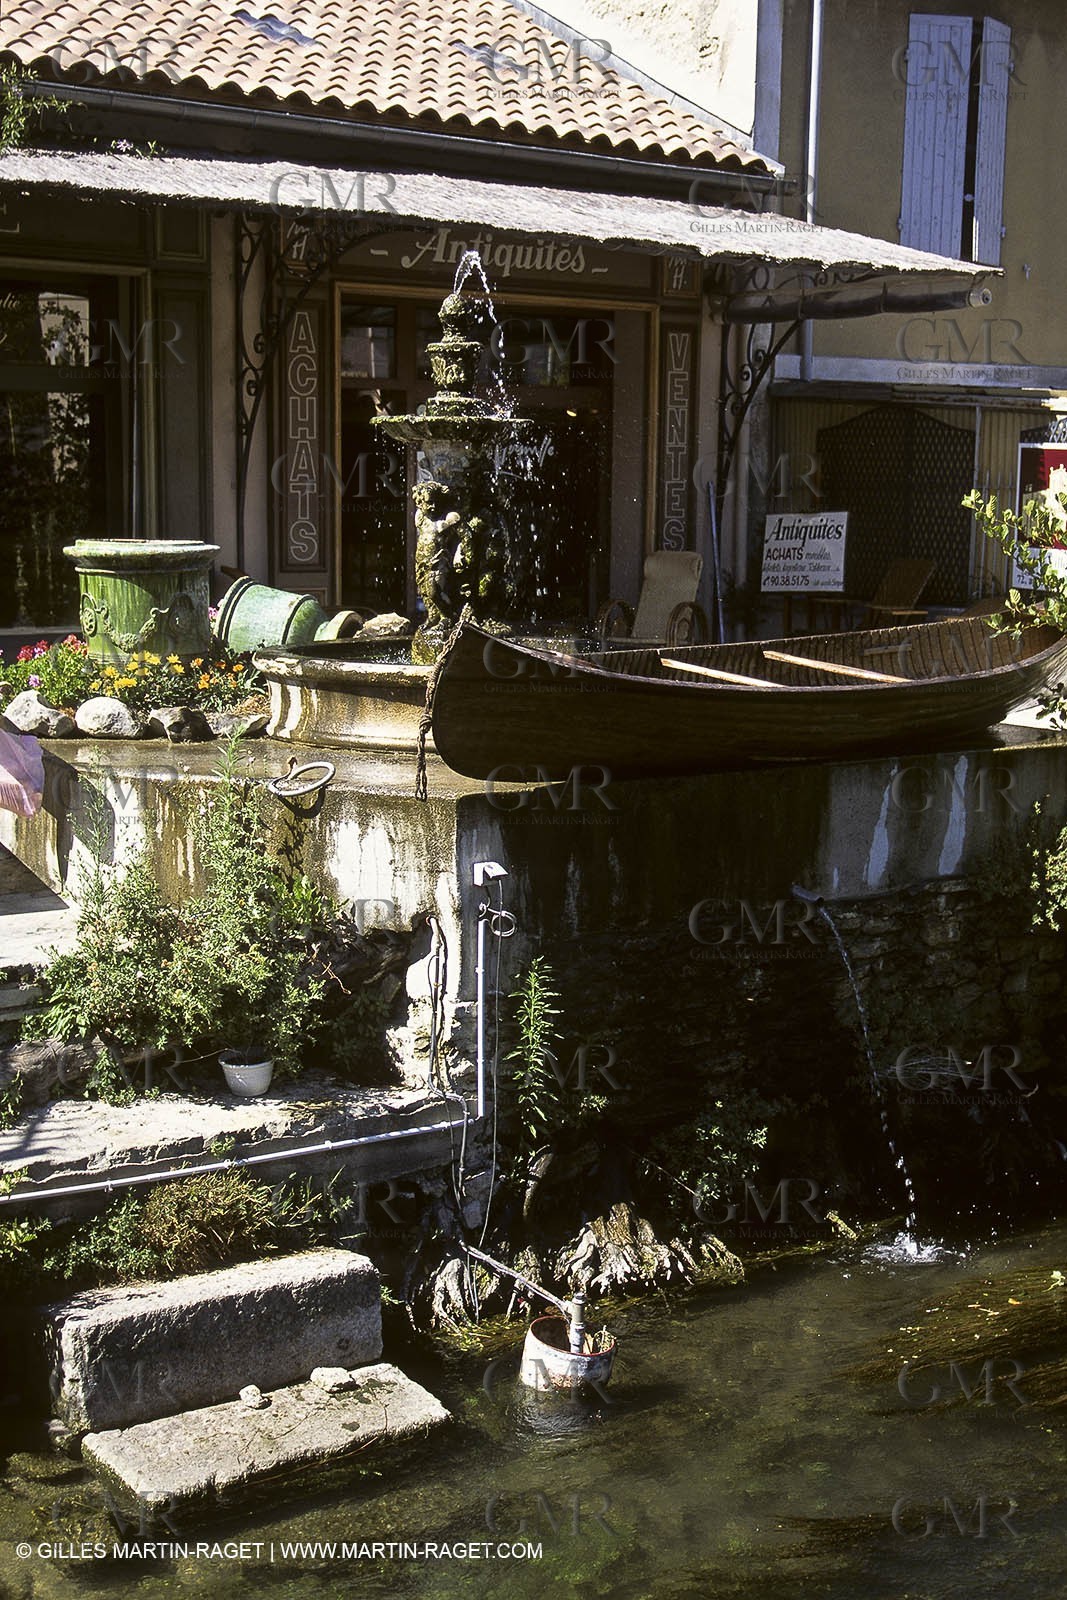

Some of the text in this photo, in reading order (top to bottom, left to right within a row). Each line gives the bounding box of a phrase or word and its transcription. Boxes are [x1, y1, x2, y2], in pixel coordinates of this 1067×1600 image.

[400, 227, 588, 279] Antiquités
[287, 311, 318, 562] ACHATS
[663, 332, 689, 552] VENTES
[764, 517, 845, 548] Antiquités
[765, 547, 804, 561] ACHATS
